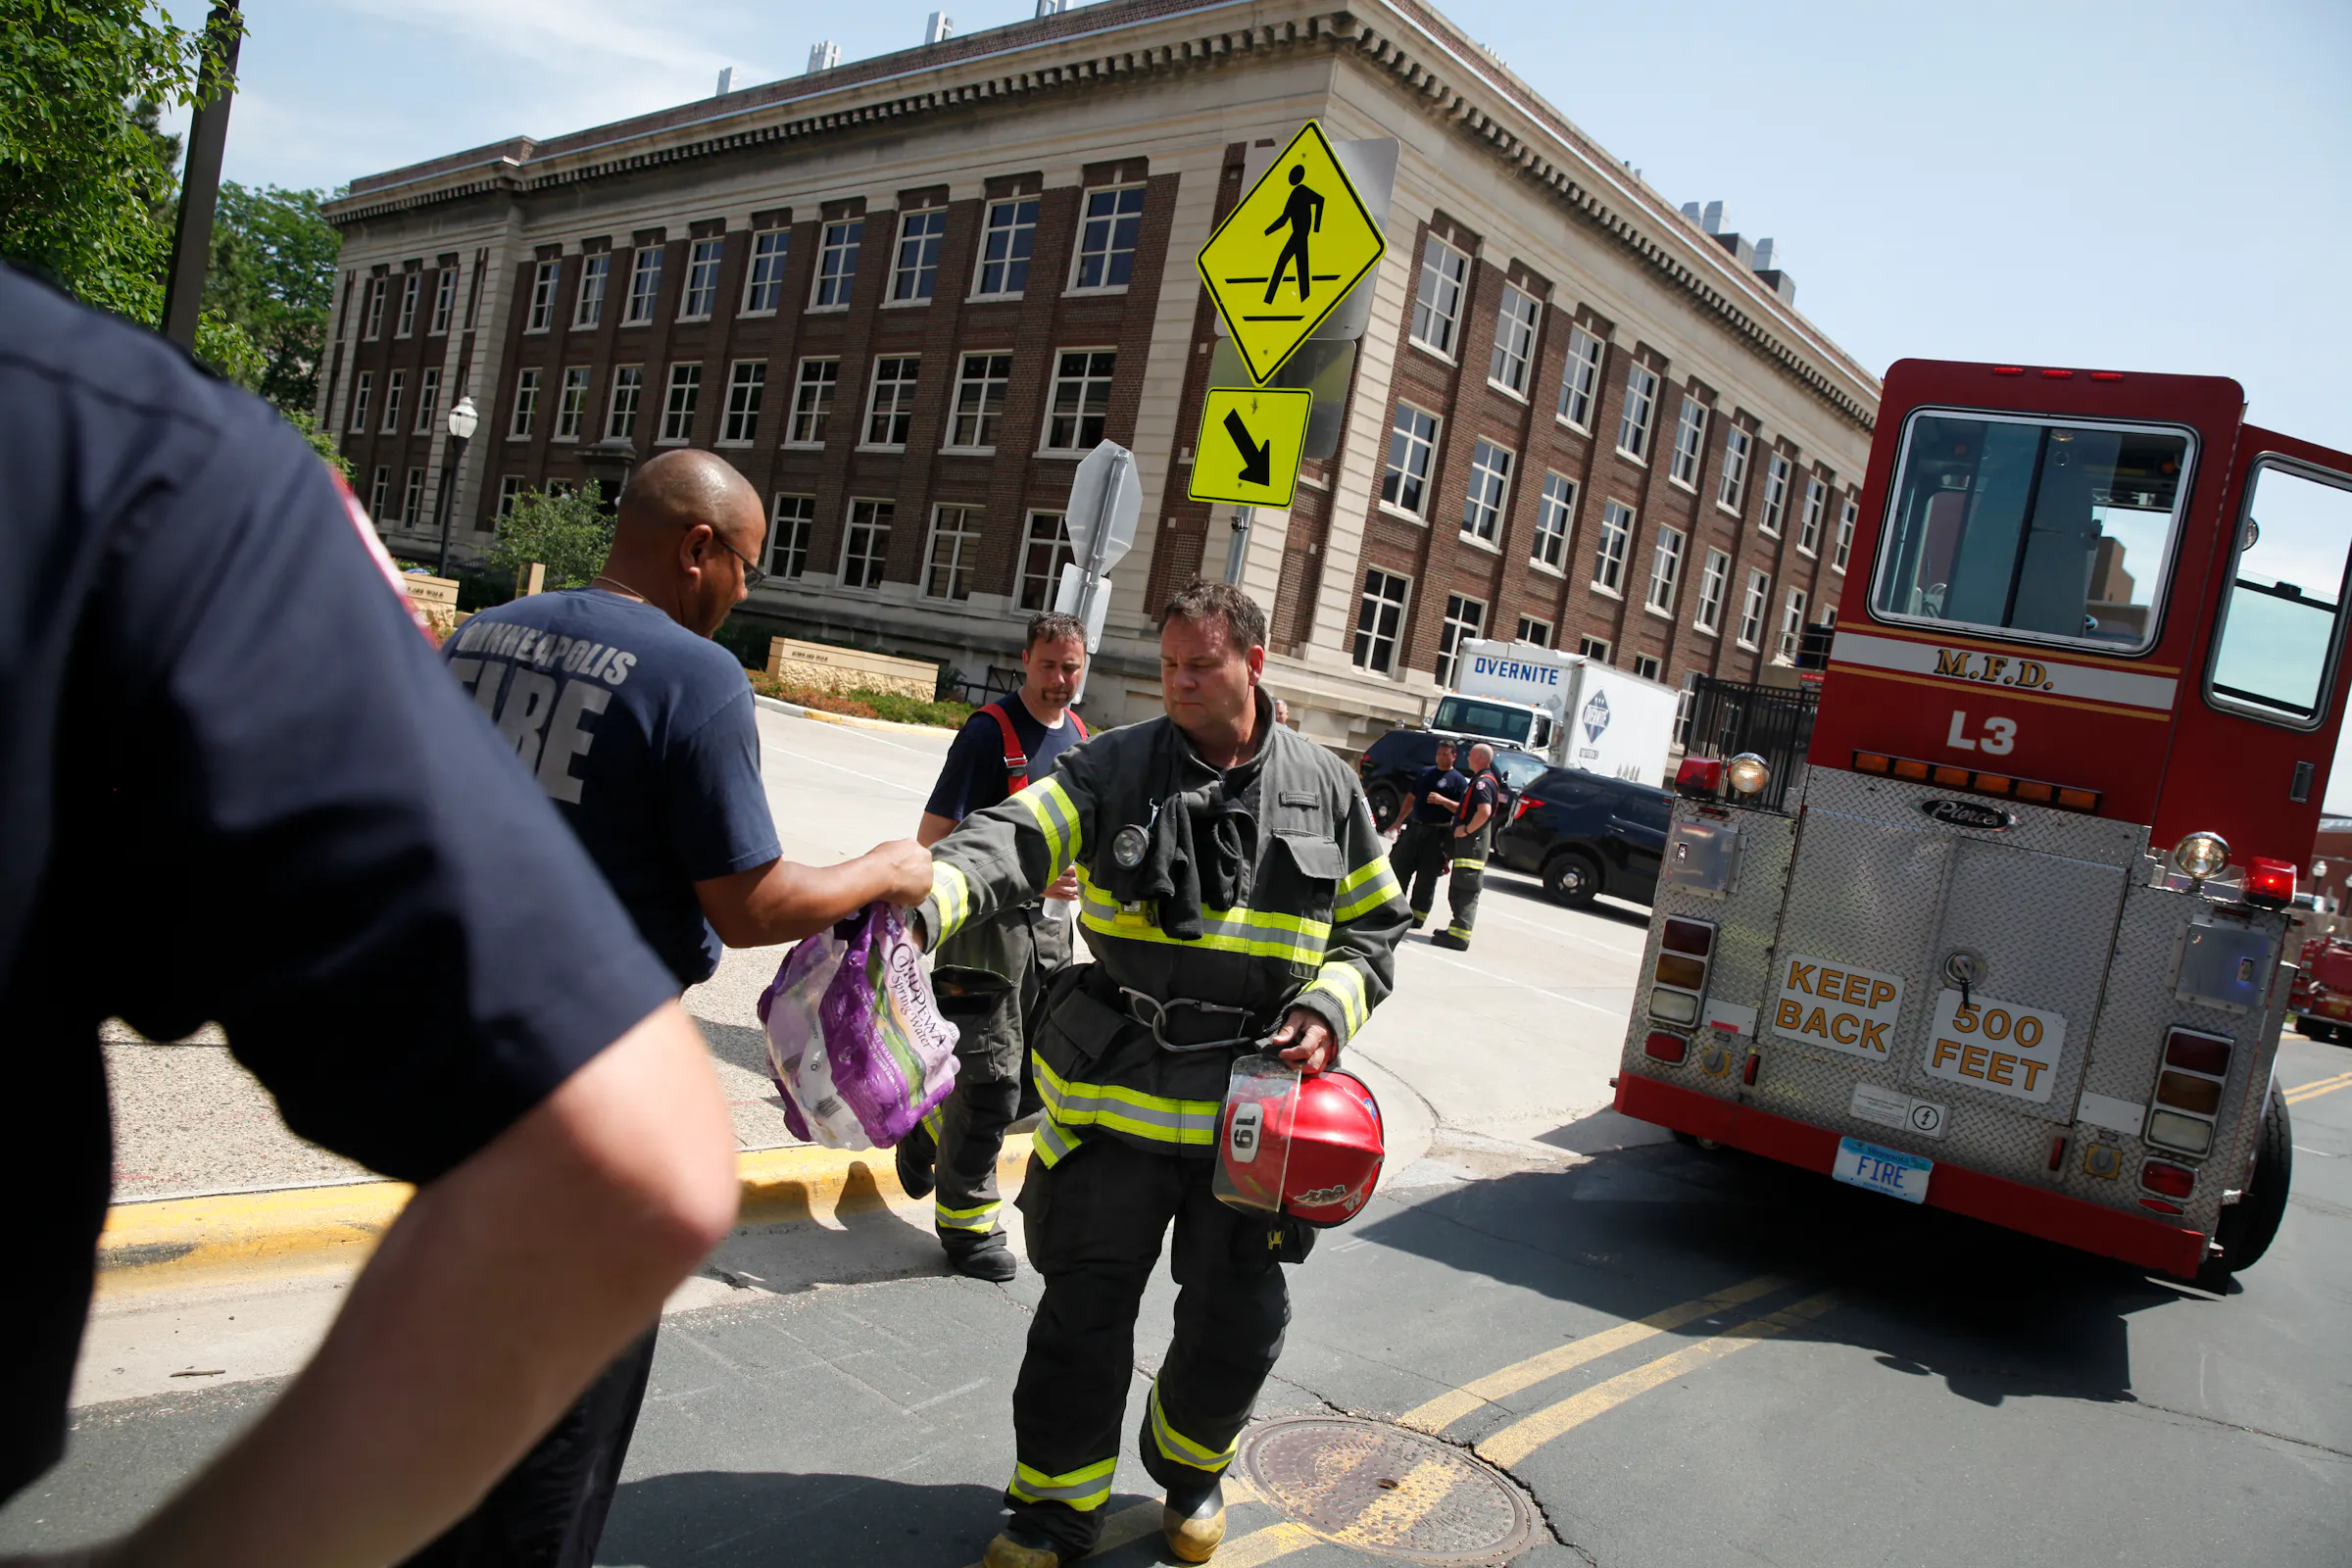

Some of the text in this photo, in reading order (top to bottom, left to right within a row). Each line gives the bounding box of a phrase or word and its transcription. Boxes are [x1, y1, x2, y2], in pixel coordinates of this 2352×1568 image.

[457, 622, 637, 685] MINNEAPOLIS
[1475, 658, 1559, 686] OVERNITE
[1934, 649, 2054, 690] M.F.D.
[1946, 710, 2018, 756] L3
[1932, 801, 1999, 826] Pierce
[1787, 960, 1896, 1009] KEEP
[891, 975, 936, 1050] Spring Water
[1775, 998, 1890, 1054] BACK
[1952, 1001, 2043, 1048] 500
[1932, 1038, 2048, 1092] FEET
[1234, 1115, 1256, 1150] 19
[1857, 1155, 1908, 1189] FIRE
